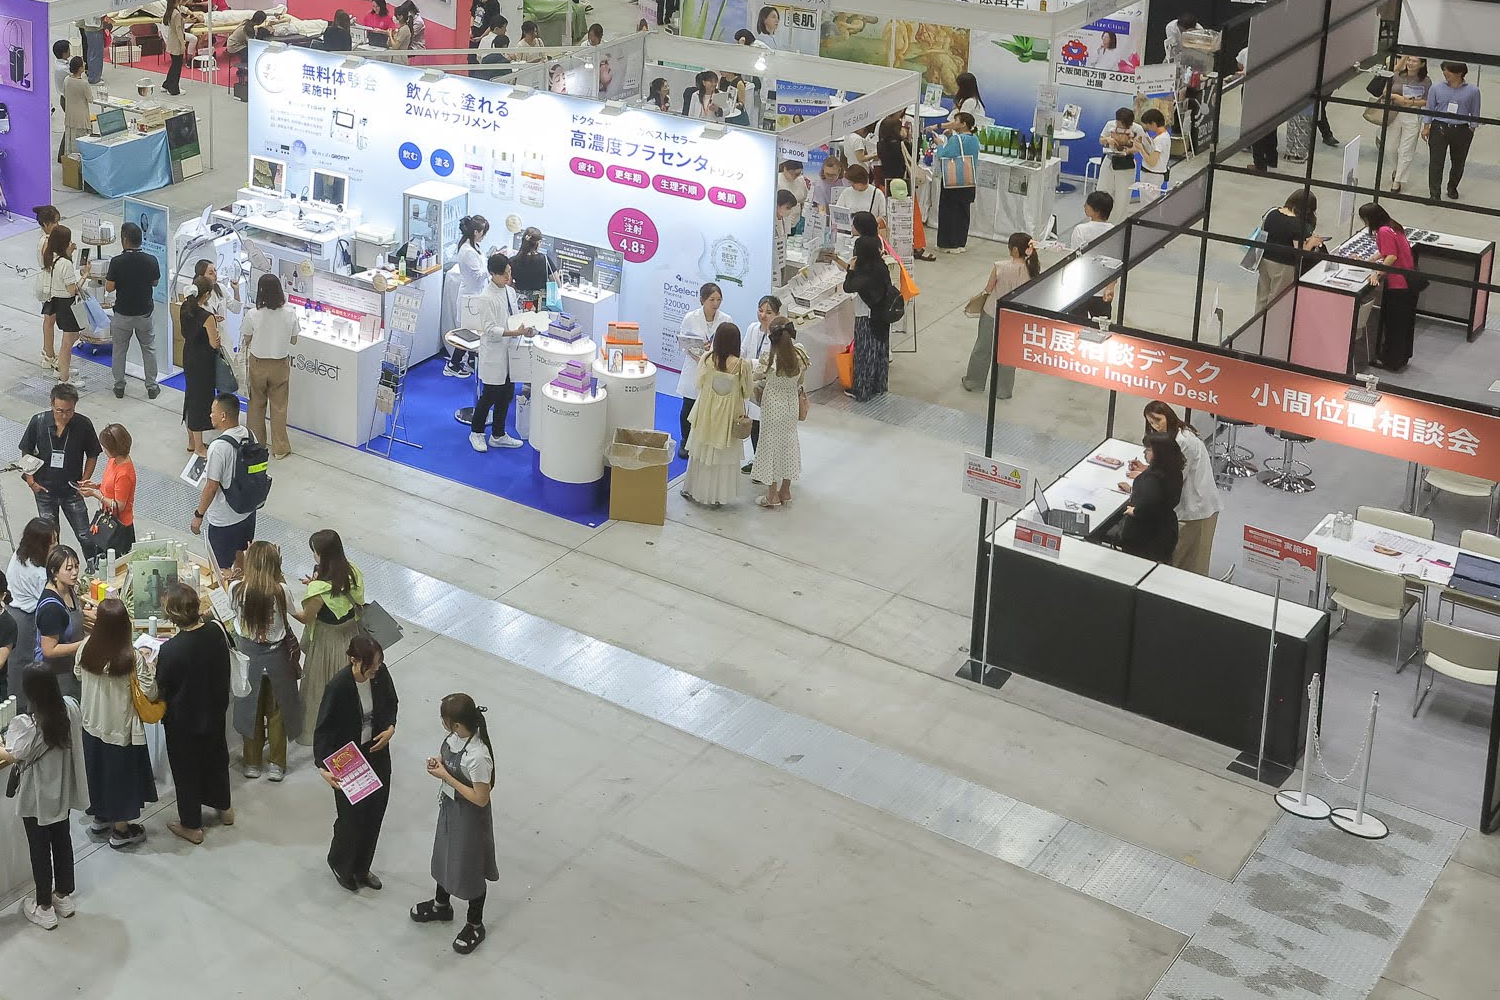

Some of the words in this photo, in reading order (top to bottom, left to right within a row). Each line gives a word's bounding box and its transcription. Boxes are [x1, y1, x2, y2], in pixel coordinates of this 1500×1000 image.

[1058, 66, 1107, 80] 大阪関西万博
[1109, 73, 1135, 83] 2025
[1086, 79, 1103, 89] 出展
[402, 150, 419, 162] 飲む
[779, 148, 805, 158] 1D-R006
[435, 157, 450, 169] 塗る
[577, 161, 596, 174] 疲れ
[613, 170, 643, 184] 更年期
[660, 179, 698, 196] 生理不順
[716, 191, 737, 204] 美肌
[624, 222, 643, 236] 注射
[663, 282, 699, 297] Dr.Select
[663, 298, 691, 311] 320000
[1021, 323, 1222, 384] 出展相談デスク
[288, 353, 341, 381] r.Select
[1022, 348, 1099, 378] Exhibitor
[1104, 366, 1168, 396] Inquiry
[1173, 382, 1219, 406] Desk
[1250, 383, 1480, 457] 小間位置相談会
